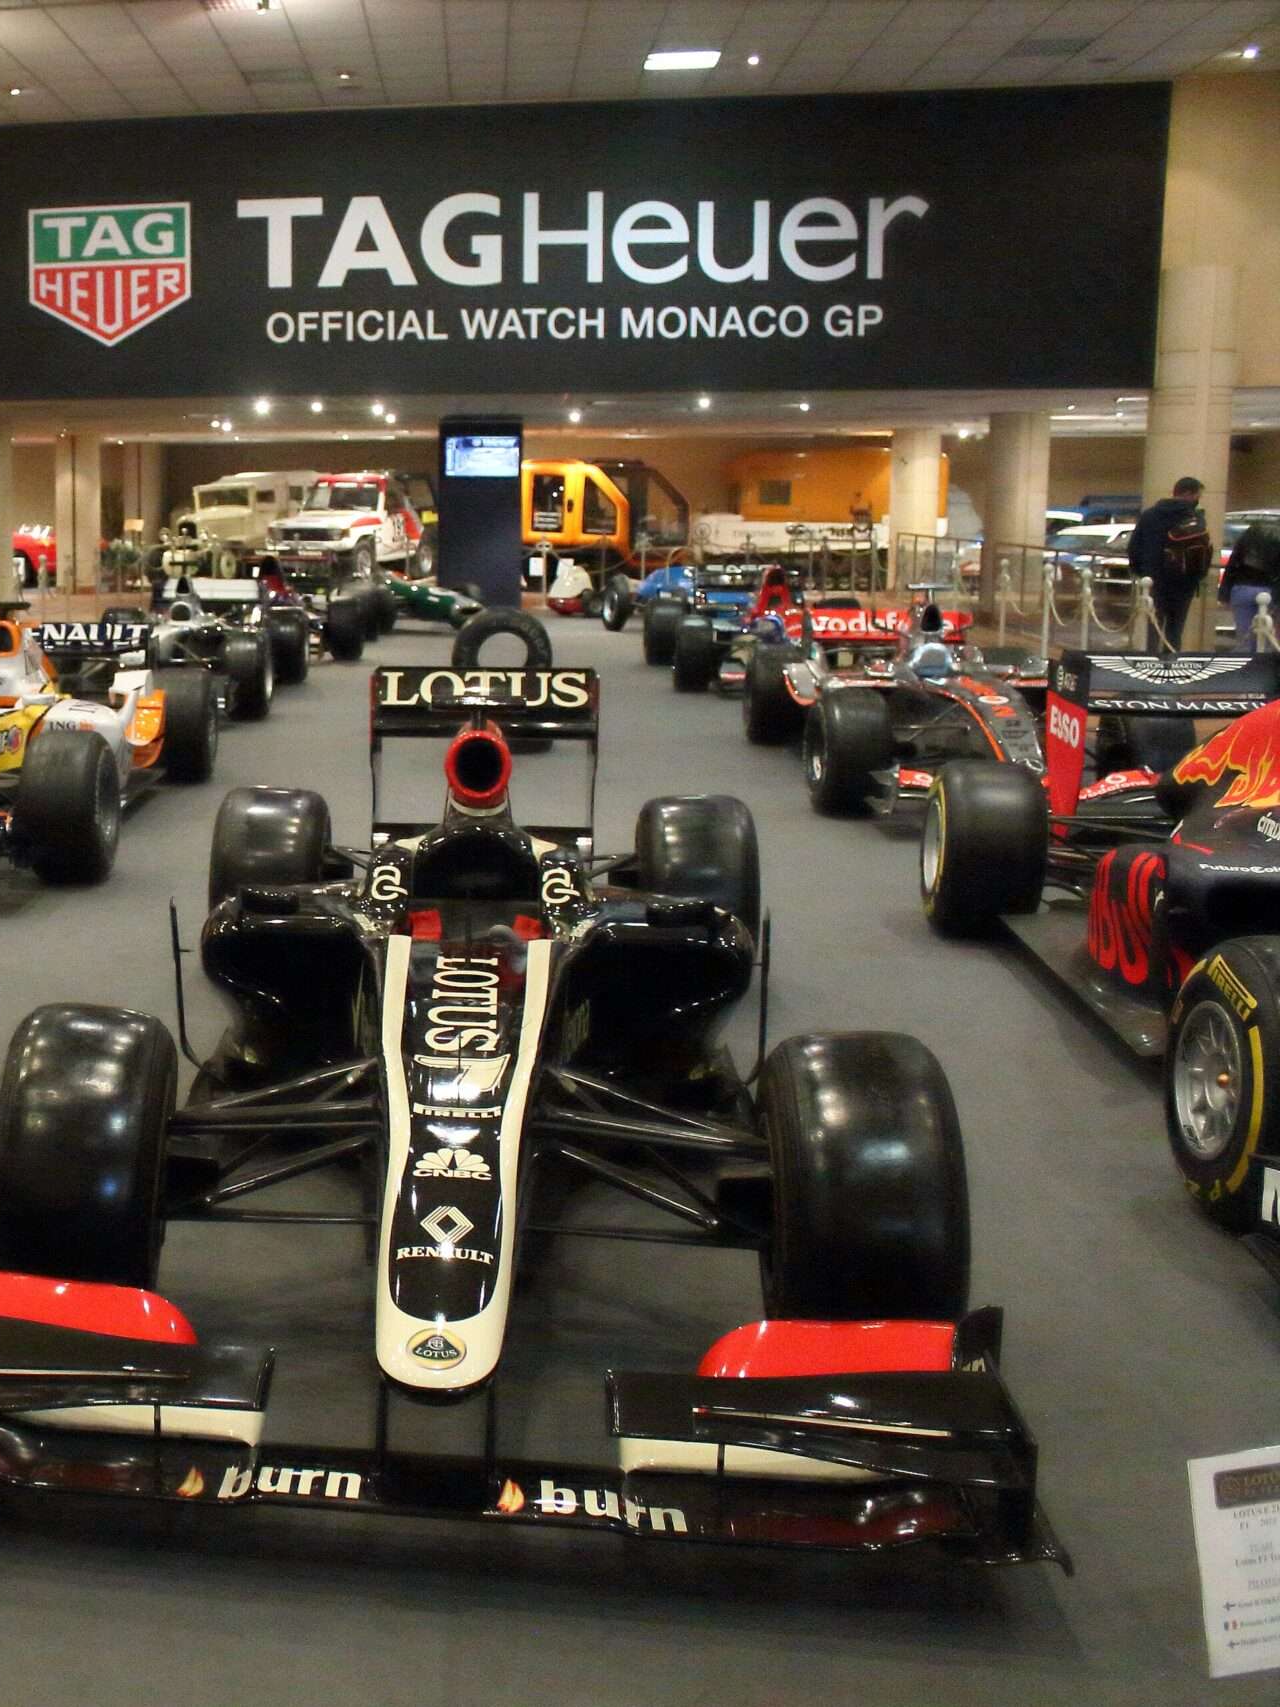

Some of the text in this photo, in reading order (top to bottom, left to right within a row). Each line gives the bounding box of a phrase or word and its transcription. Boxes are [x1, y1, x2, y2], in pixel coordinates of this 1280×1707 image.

[41, 211, 175, 259] TAG
[38, 266, 182, 334] HEUER
[265, 303, 885, 343] OFFICIAL WATCH MONACO GP
[30, 622, 150, 647] NAULT
[380, 670, 589, 708] LOTUS
[1088, 699, 1267, 712] STON MARTI
[49, 721, 76, 731] ING
[424, 955, 500, 1052] LOTUS
[1206, 954, 1258, 1022] PIRELLI
[412, 1102, 503, 1119] PIRELLI
[412, 1167, 493, 1181] CNBC
[415, 1346, 458, 1358] LOTUS
[216, 1464, 362, 1500] burn
[540, 1479, 689, 1533] burn
